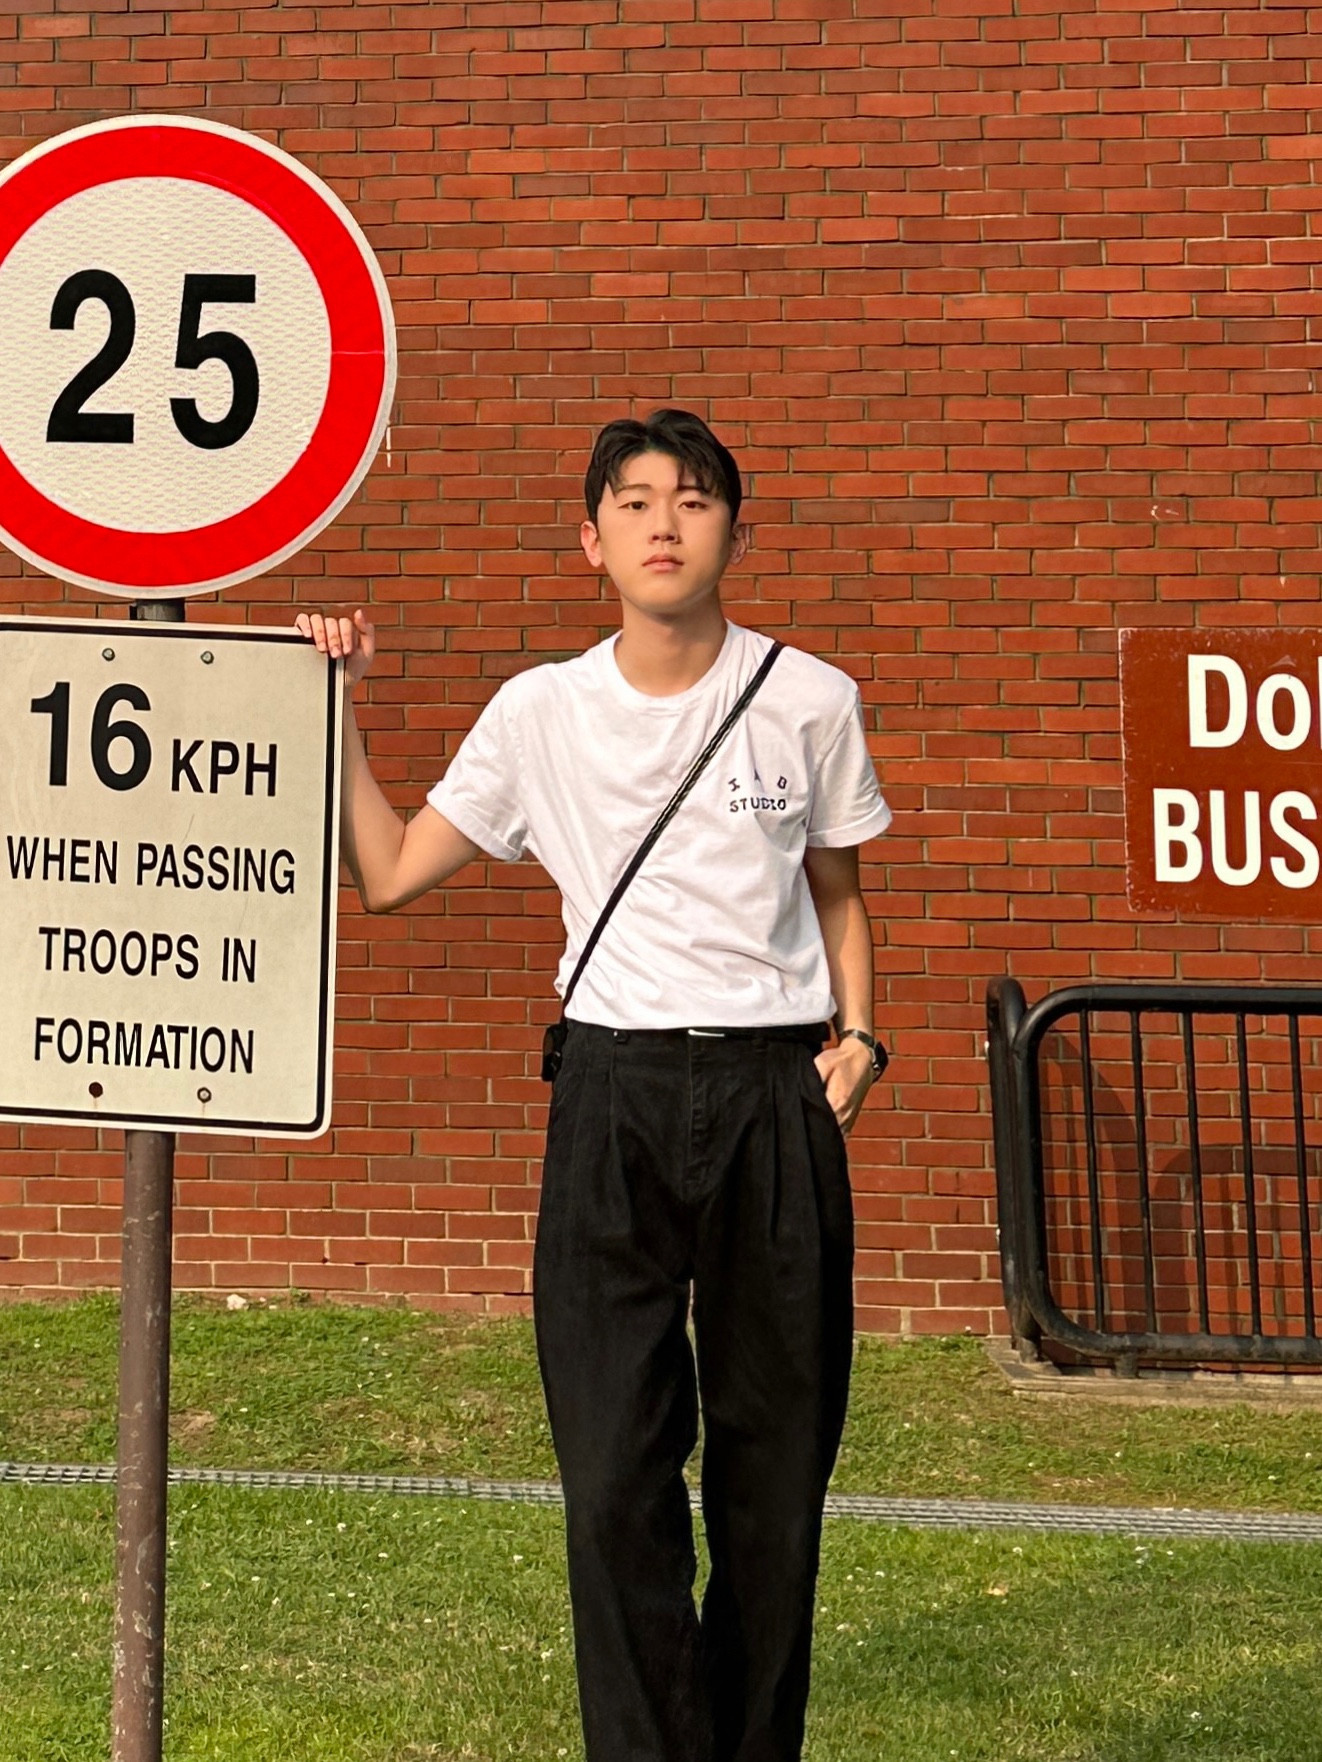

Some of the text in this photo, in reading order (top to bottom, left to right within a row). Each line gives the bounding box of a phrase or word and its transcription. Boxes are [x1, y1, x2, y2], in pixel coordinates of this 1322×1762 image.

[46, 268, 260, 450] 25
[30, 681, 278, 797] 16 KPH
[1187, 653, 1322, 751] Do
[7, 835, 296, 894] WHEN PASSING
[1153, 788, 1320, 889] BUS
[39, 927, 256, 982] TROOPS IN
[34, 1017, 254, 1074] FORMATION
